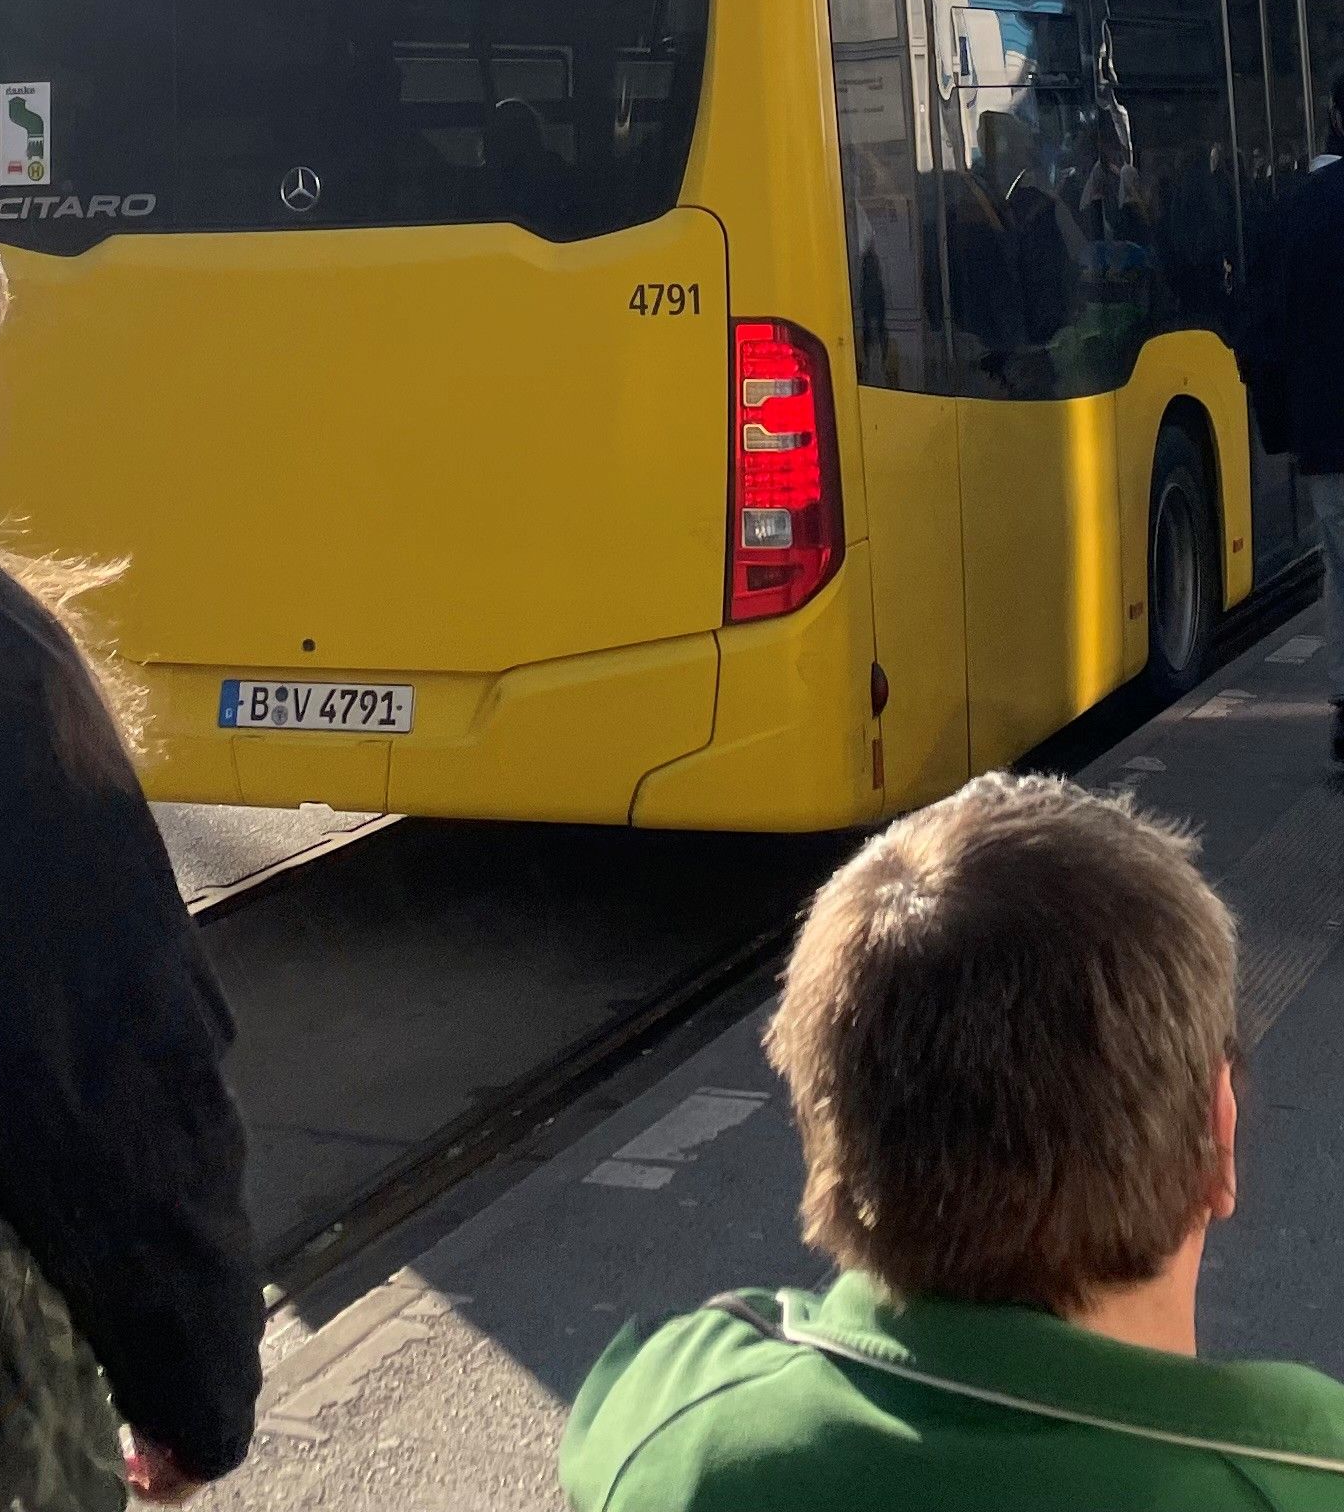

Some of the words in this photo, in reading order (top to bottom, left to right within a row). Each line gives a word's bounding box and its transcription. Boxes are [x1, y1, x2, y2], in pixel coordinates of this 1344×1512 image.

[629, 283, 700, 316] 4791
[250, 686, 270, 722] B
[293, 688, 312, 723] V
[319, 688, 397, 727] 4791
